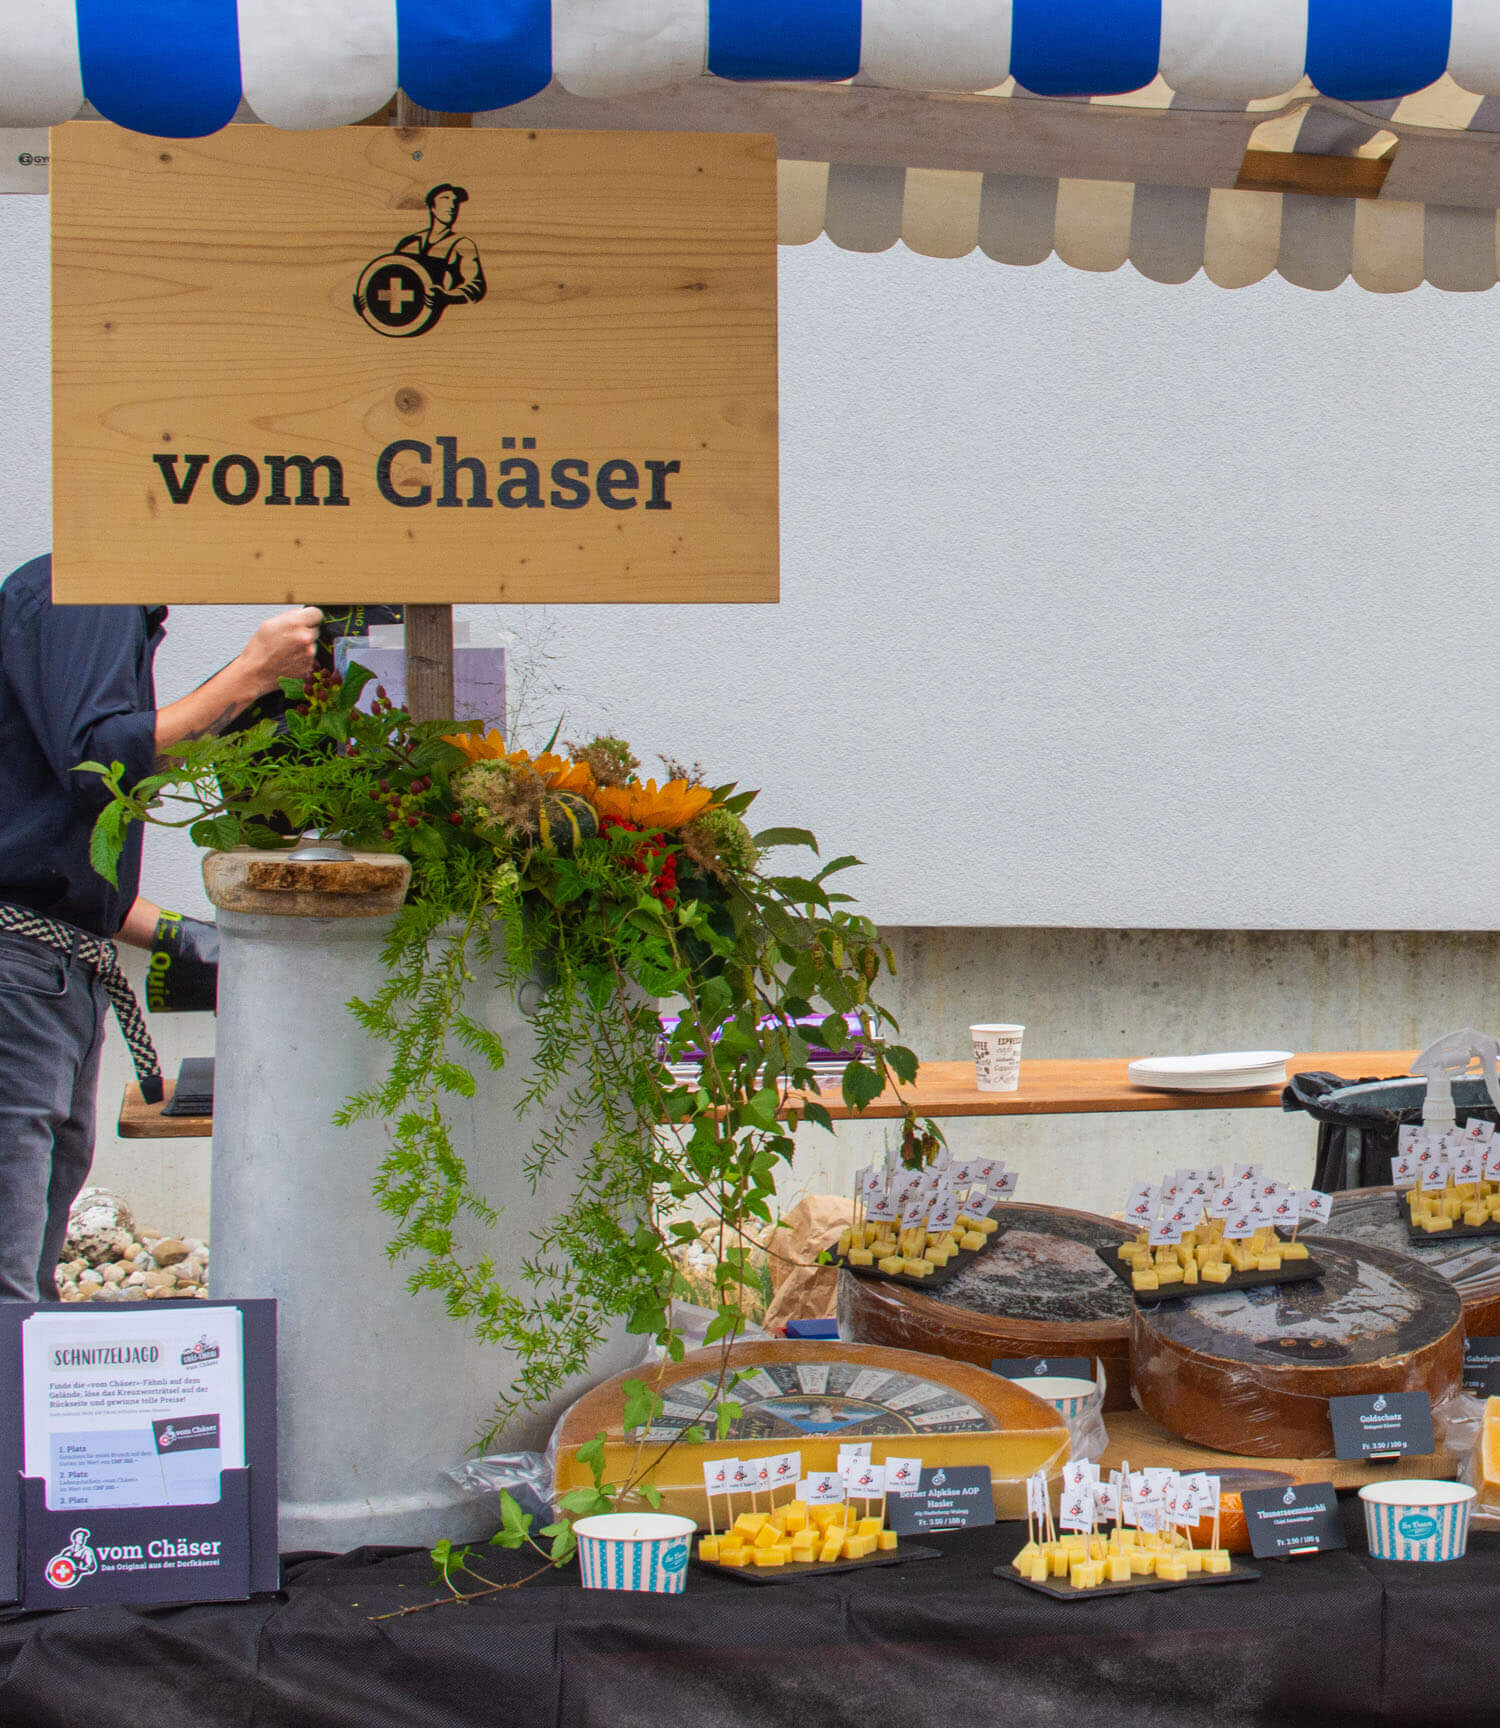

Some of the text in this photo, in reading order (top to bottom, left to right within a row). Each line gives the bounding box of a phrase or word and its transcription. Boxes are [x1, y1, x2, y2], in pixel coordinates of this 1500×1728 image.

[153, 436, 681, 512] vom Chäser
[54, 1345, 160, 1366] SCHNITZELJAGD
[1359, 1413, 1402, 1423] Goldschatz
[66, 1445, 87, 1453] Platz
[961, 1486, 980, 1496] AOP
[68, 1496, 88, 1504] Platz
[96, 1537, 222, 1561] vom Chäser
[101, 1558, 220, 1573] Das Original aus der Dorfkäserei
